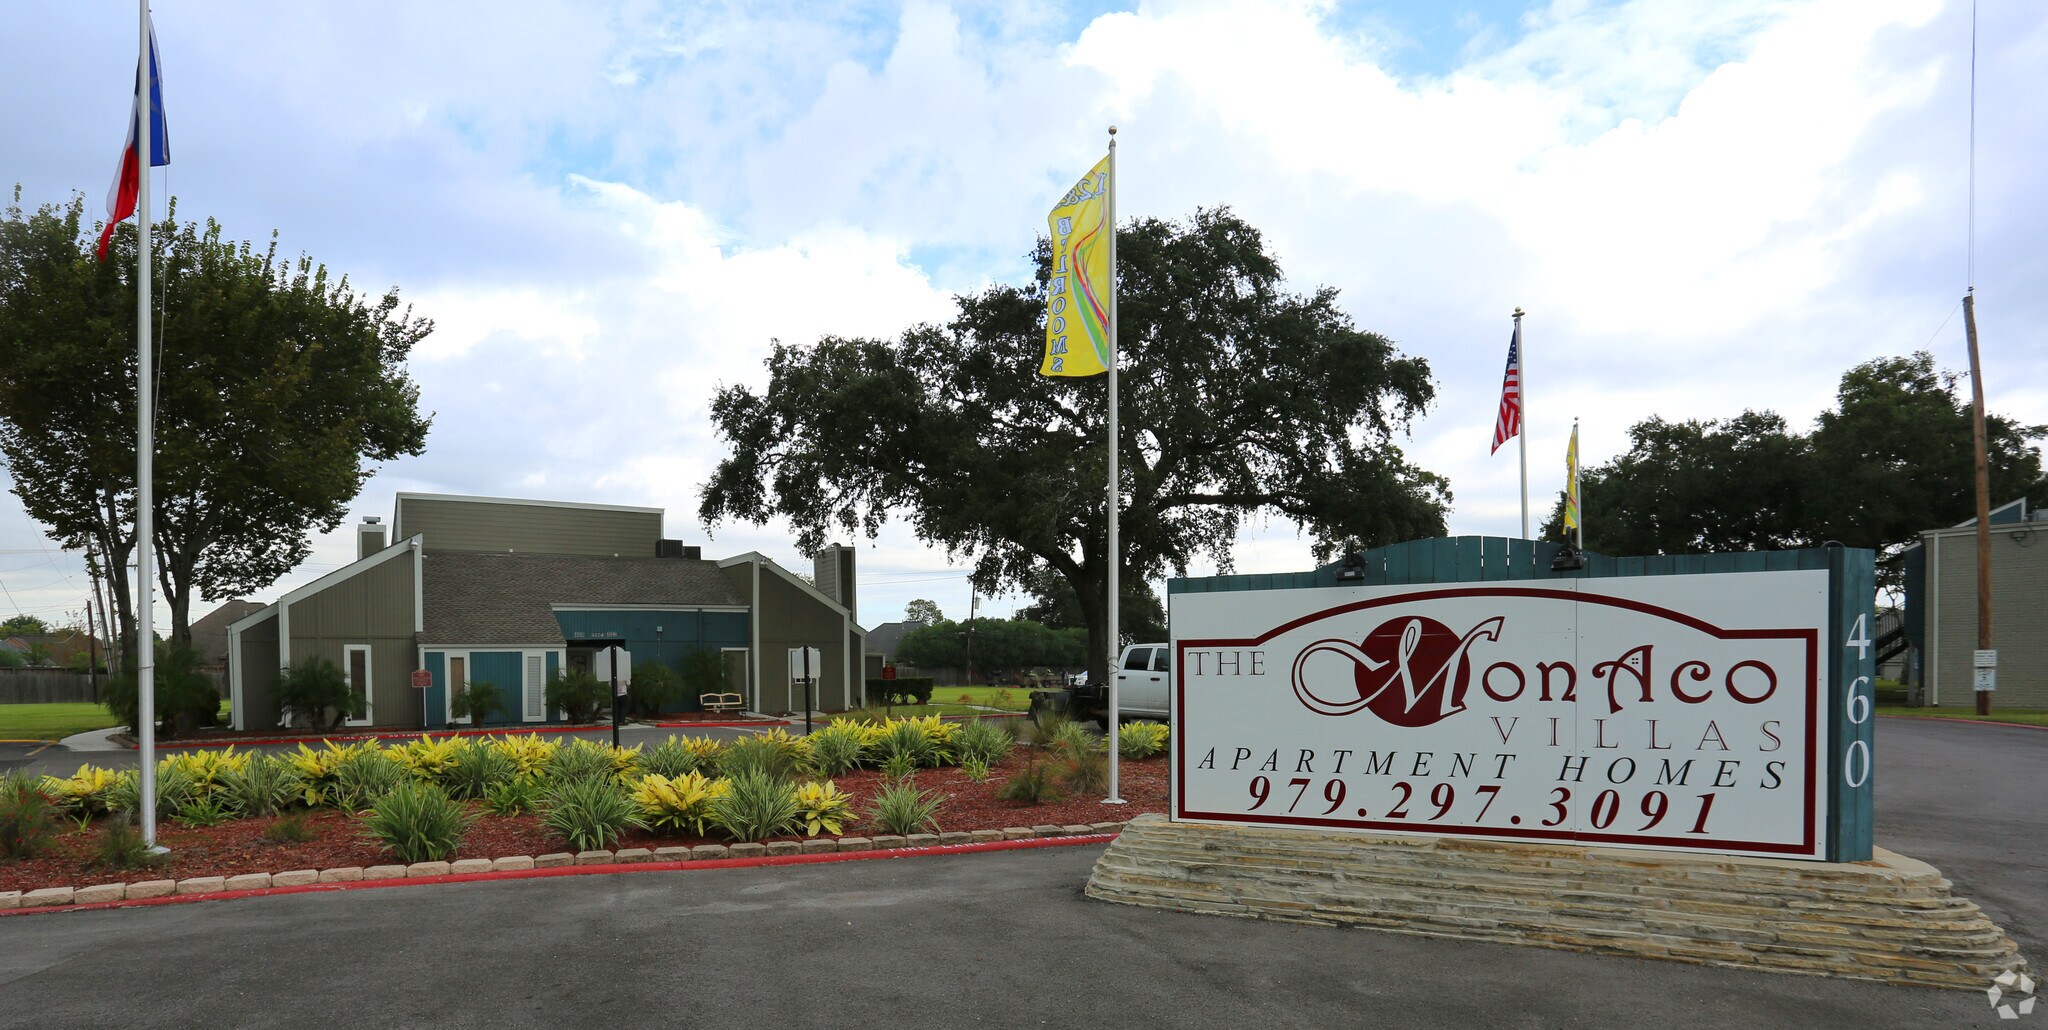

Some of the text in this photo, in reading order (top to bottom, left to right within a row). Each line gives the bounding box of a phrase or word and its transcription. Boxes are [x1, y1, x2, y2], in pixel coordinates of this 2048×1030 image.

[1187, 650, 1266, 676] THE
[1844, 612, 1871, 788] 460
[1489, 716, 1782, 752] VILLAS
[1196, 746, 1786, 790] APARTMENT HOMES
[1246, 775, 1716, 835] 979.297.3091
